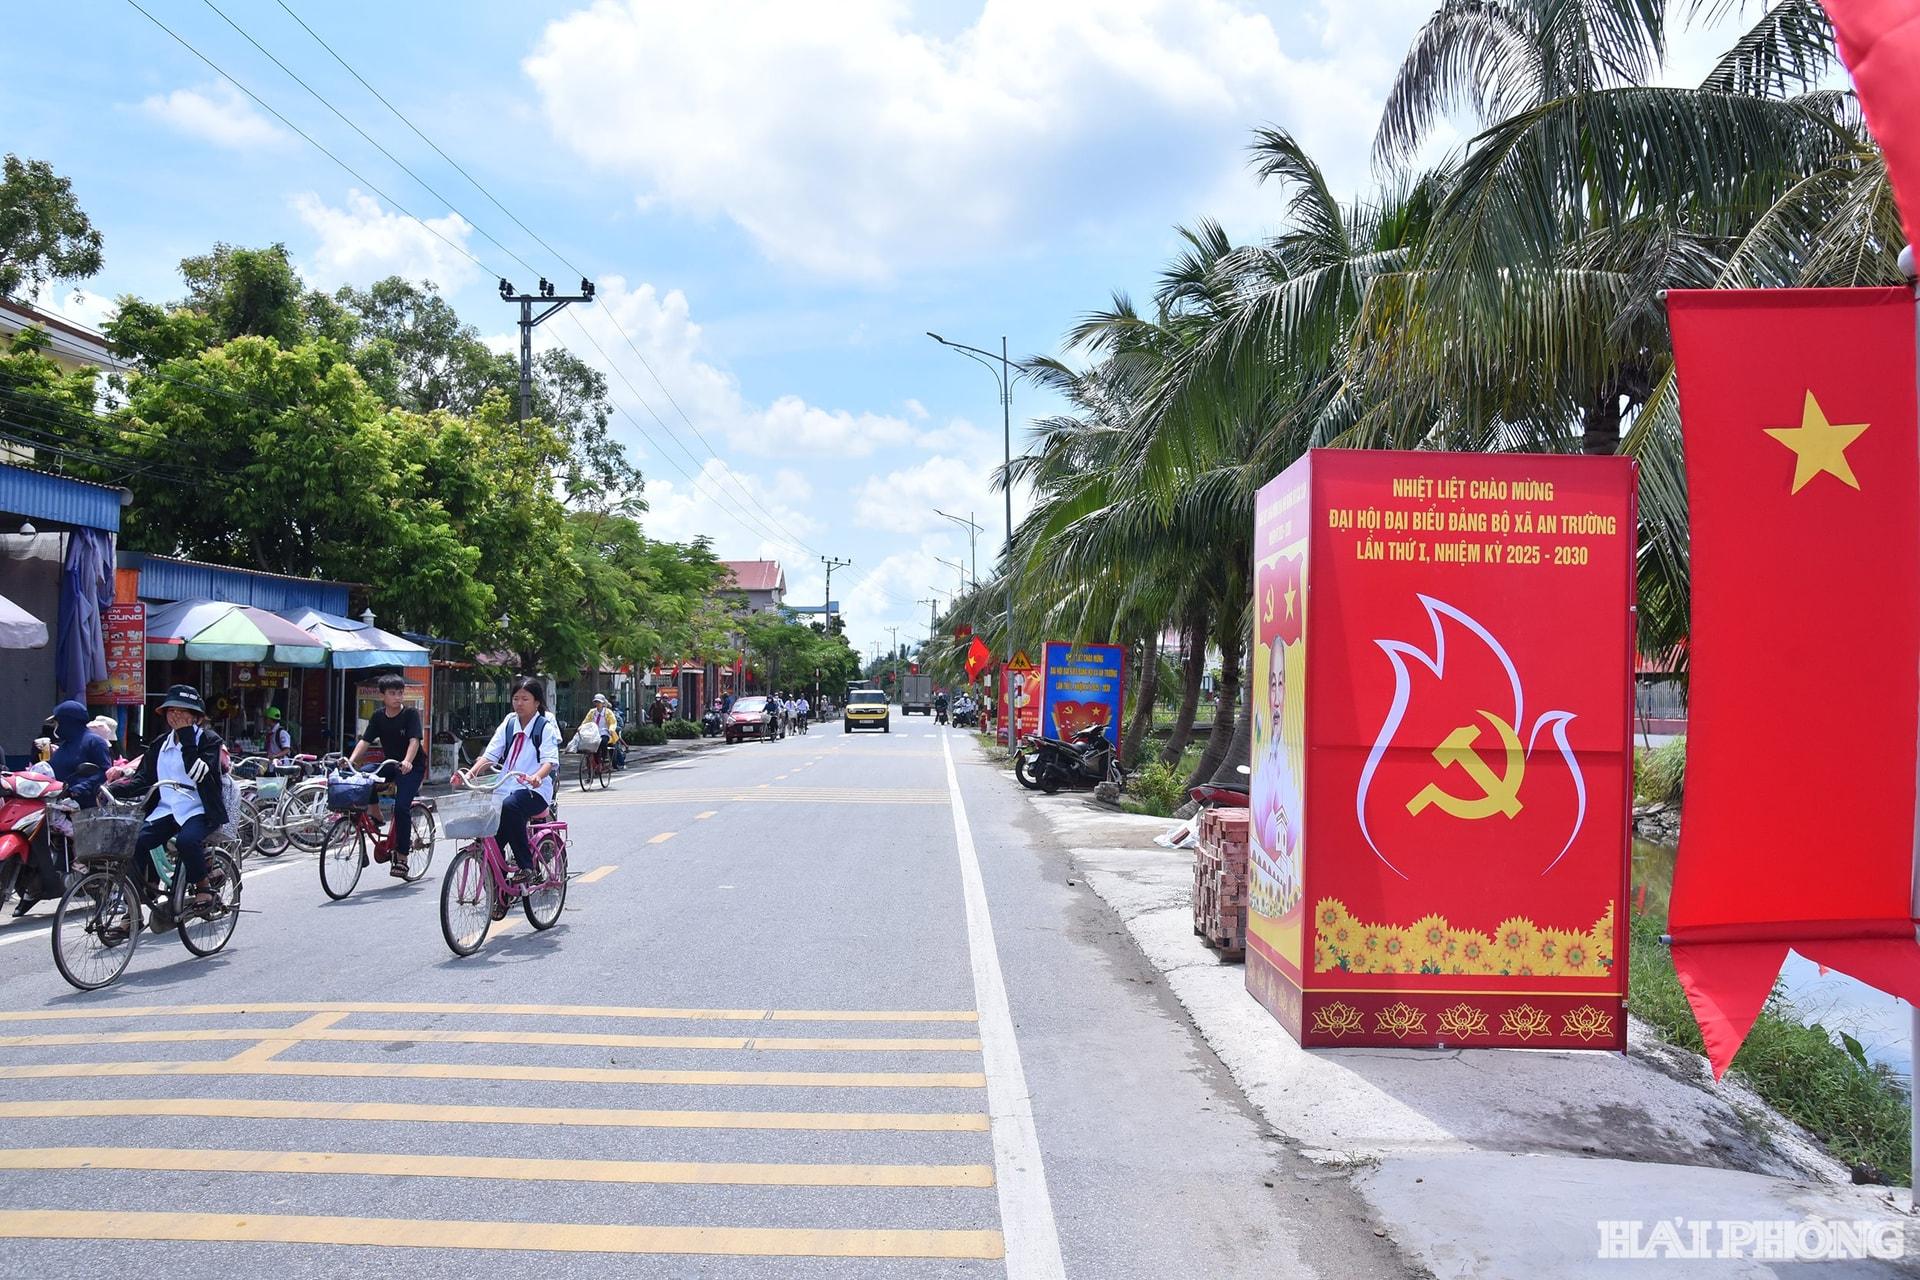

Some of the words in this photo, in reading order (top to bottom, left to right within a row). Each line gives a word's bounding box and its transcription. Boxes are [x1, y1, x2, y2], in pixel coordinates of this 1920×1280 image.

[1393, 475, 1433, 502] NHIỆT
[1438, 476, 1466, 503] LIỆT
[1470, 476, 1507, 500] CHÀO
[1512, 477, 1554, 501] MỪNG
[1329, 509, 1353, 533] ĐẠI
[1357, 506, 1381, 533] HỘI
[1385, 510, 1408, 534] ĐẠI
[1412, 503, 1445, 531] BIỂU
[1448, 506, 1487, 532] ĐẢNG
[1491, 510, 1510, 537] BỘ
[1514, 510, 1533, 533] XÃ
[1537, 514, 1557, 534] AN
[1561, 511, 1616, 535] TRƯỜNG
[1356, 534, 1384, 560] LẦN
[1388, 537, 1416, 561] THỨ
[1418, 542, 1430, 564] I,
[1434, 539, 1480, 567] NHIỆM
[1485, 540, 1503, 564] KỲ
[1506, 544, 1541, 565] 2025
[1554, 546, 1588, 566] 2030
